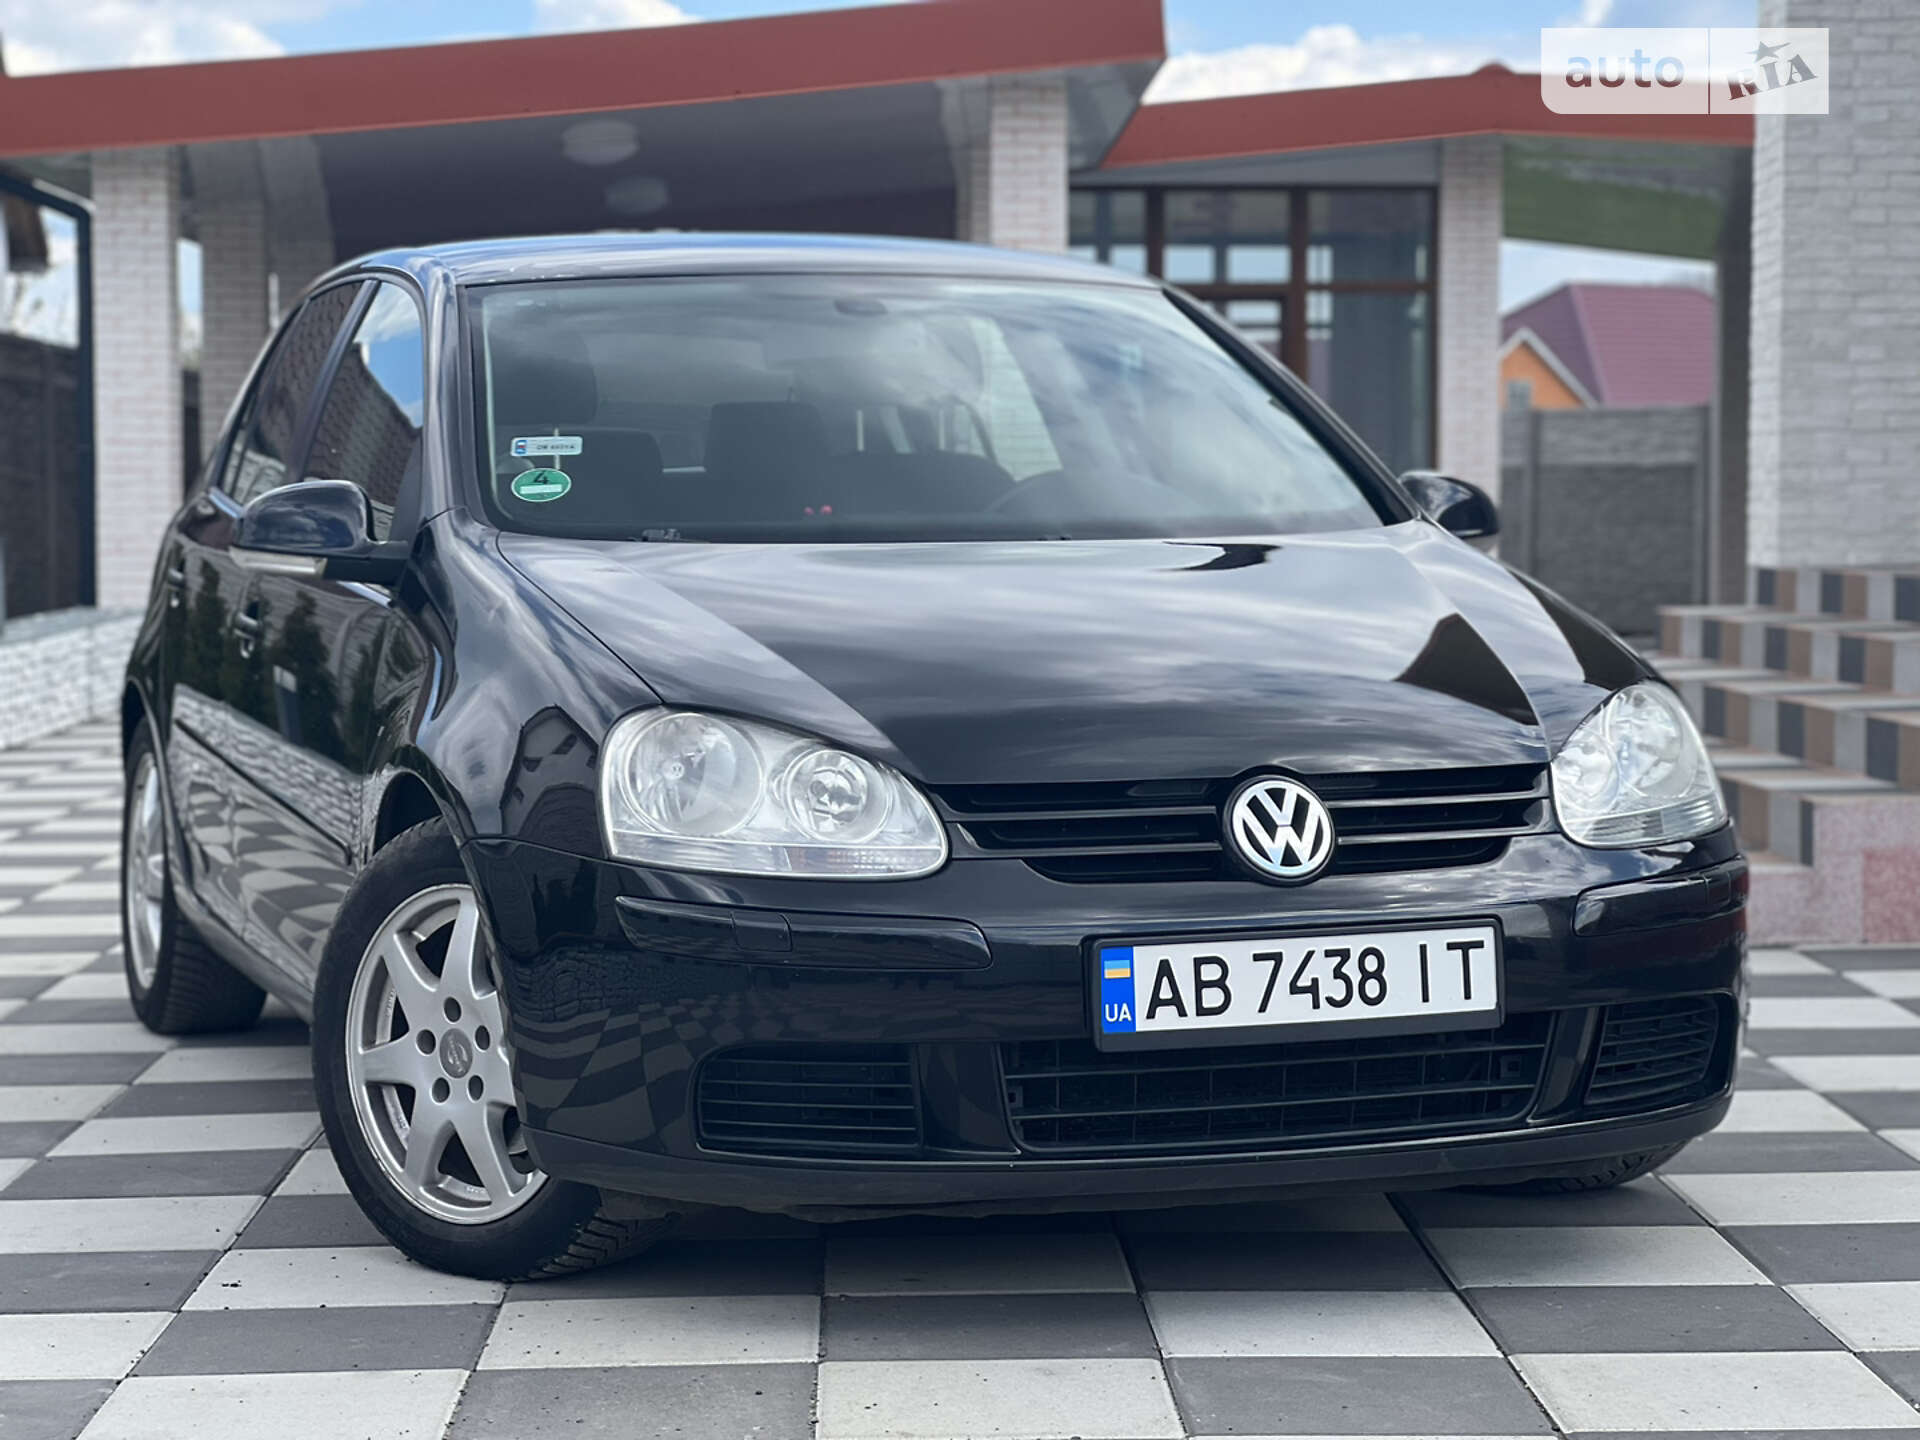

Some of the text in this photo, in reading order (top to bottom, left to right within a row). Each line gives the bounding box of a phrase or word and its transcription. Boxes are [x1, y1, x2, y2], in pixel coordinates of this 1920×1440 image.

[533, 470, 549, 484] 4
[1236, 783, 1330, 874] VW
[1145, 939, 1485, 1020] AB 7438 IT
[1105, 1002, 1132, 1023] UA
